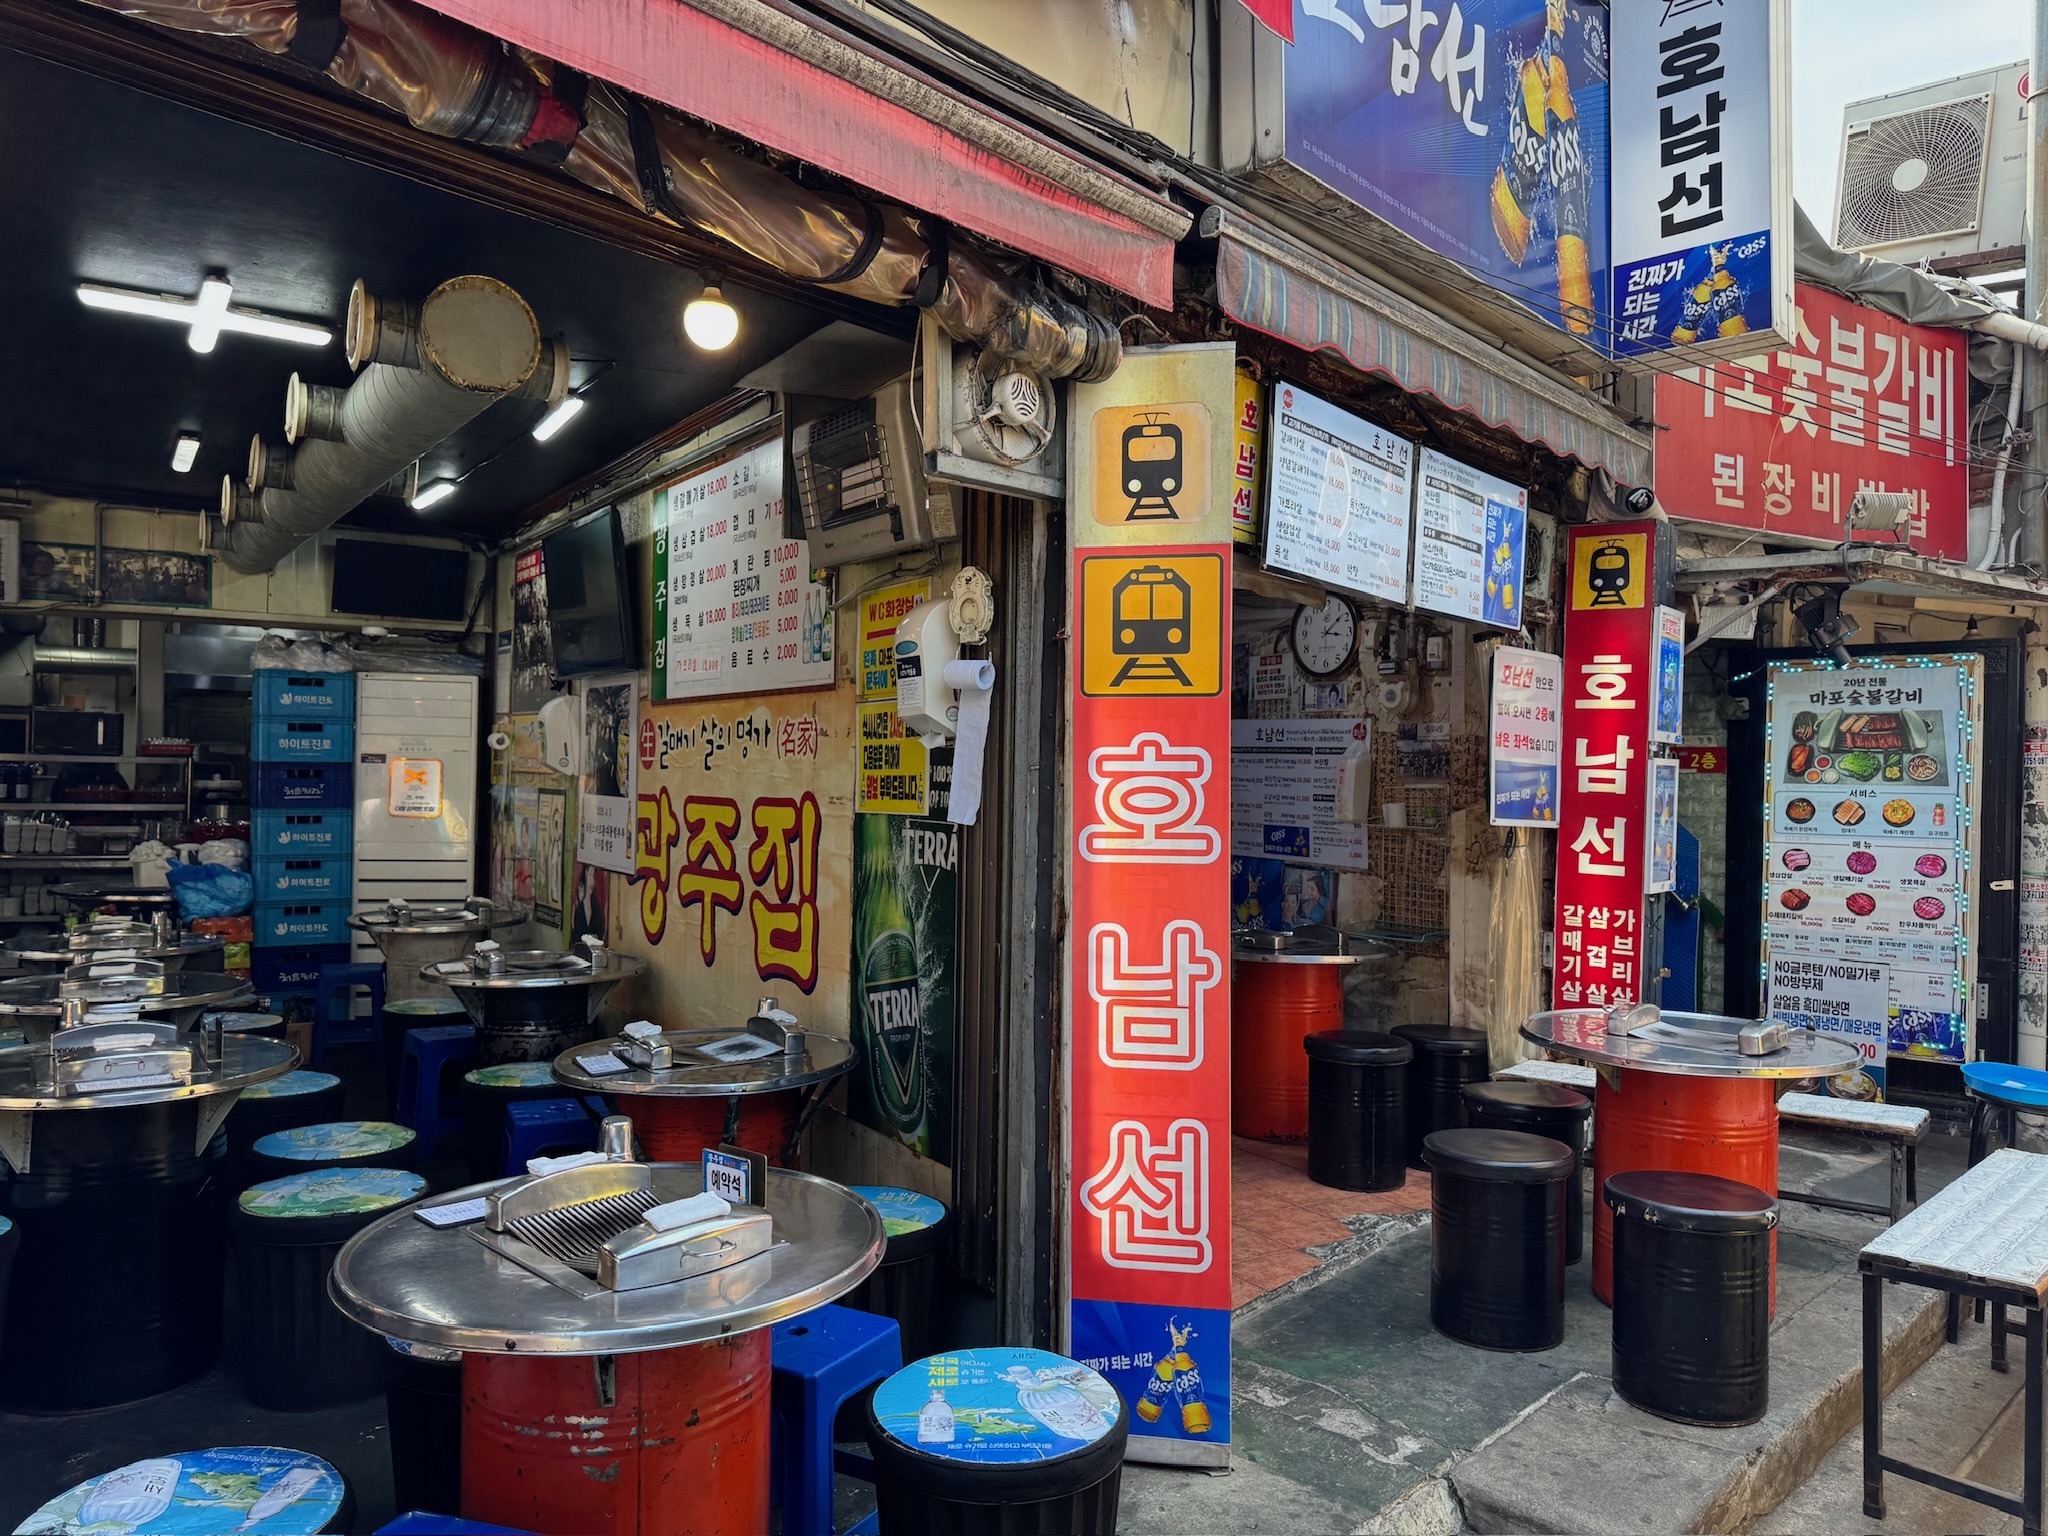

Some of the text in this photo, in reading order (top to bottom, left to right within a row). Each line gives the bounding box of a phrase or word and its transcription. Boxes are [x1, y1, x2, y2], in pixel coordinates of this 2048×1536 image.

[1301, 0, 1489, 137] 남선
[1657, 22, 1727, 239] 호남선
[2002, 153, 2023, 162] Smart
[1559, 175, 1577, 197] FRESH
[1627, 258, 1686, 292] 진짜가
[1622, 292, 1661, 317] 되는
[1619, 315, 1658, 342] 시간
[1280, 430, 1305, 452] 갈매기살
[1372, 432, 1408, 465] 호남선
[1233, 400, 1259, 523] 호남선
[706, 475, 728, 497] 18,000
[1278, 495, 1303, 516] 가브리살
[1386, 513, 1403, 527] 20,000
[673, 527, 706, 552] 생삼겹살
[706, 519, 728, 540] 18,000
[733, 541, 799, 575] 계란찜 10,000
[1384, 544, 1401, 558] 21,000
[706, 564, 727, 582] 20,000
[733, 565, 797, 597] 된장찌개 5,000
[654, 524, 669, 669] 광주집
[777, 588, 798, 607] 6,000
[705, 607, 727, 624] 18,000
[777, 616, 798, 633] 5,000
[1303, 615, 1313, 626] 10
[1344, 612, 1349, 622] 2
[1302, 629, 1308, 640] 9
[1346, 626, 1352, 637] 3
[731, 643, 798, 668] 음료수 2,000
[1303, 644, 1310, 654] 8
[1342, 642, 1348, 652] 4
[1311, 655, 1317, 665] 7
[1323, 658, 1329, 668] 6
[1334, 653, 1341, 665] 5
[1500, 664, 1554, 691] 호남선 안으로
[1843, 677, 1887, 687] 20년 전통
[1809, 687, 1923, 706] 마포숯불갈비
[1513, 704, 1532, 720] 오시면
[1535, 706, 1556, 723] 2층에
[279, 738, 333, 750] 하이트진로
[640, 719, 656, 769] 生
[657, 715, 820, 771] 갈매기 살의 명가 (名家)
[1255, 728, 1285, 742] 호남선
[1569, 654, 1636, 878] 호남선
[1690, 752, 1716, 769] 2층
[1849, 789, 1878, 798] 서비스
[292, 832, 332, 842] 하이트진로
[1852, 840, 1872, 849] 메뉴
[901, 824, 958, 873] TERRA
[290, 877, 331, 887] 하이트진로
[1769, 871, 1793, 879] 생삼겹살
[1832, 875, 1864, 883] 생갈매기살
[632, 785, 822, 996] 광주집
[1831, 917, 1856, 925] 소갈비살
[1898, 921, 1938, 930] 한우차돌박이
[1561, 903, 1585, 1004] 갈매기살
[1585, 906, 1611, 1007] 삼겹살
[1611, 909, 1636, 1009] 가브리살
[1774, 960, 1881, 983] NO글루텐/NO밀가루
[1774, 974, 1824, 992] NO방부제
[869, 985, 921, 1036] TERRA
[1078, 731, 1223, 1275] 호남선
[1772, 994, 1850, 1017] 살얼음 흑미쌀냉면
[711, 1169, 741, 1197] 예약석
[929, 1356, 959, 1366] 전국
[1011, 1352, 1037, 1360] 새로
[1111, 1351, 1154, 1371] 되는 시간
[928, 1366, 959, 1377] 제로
[928, 1377, 959, 1388] 새로
